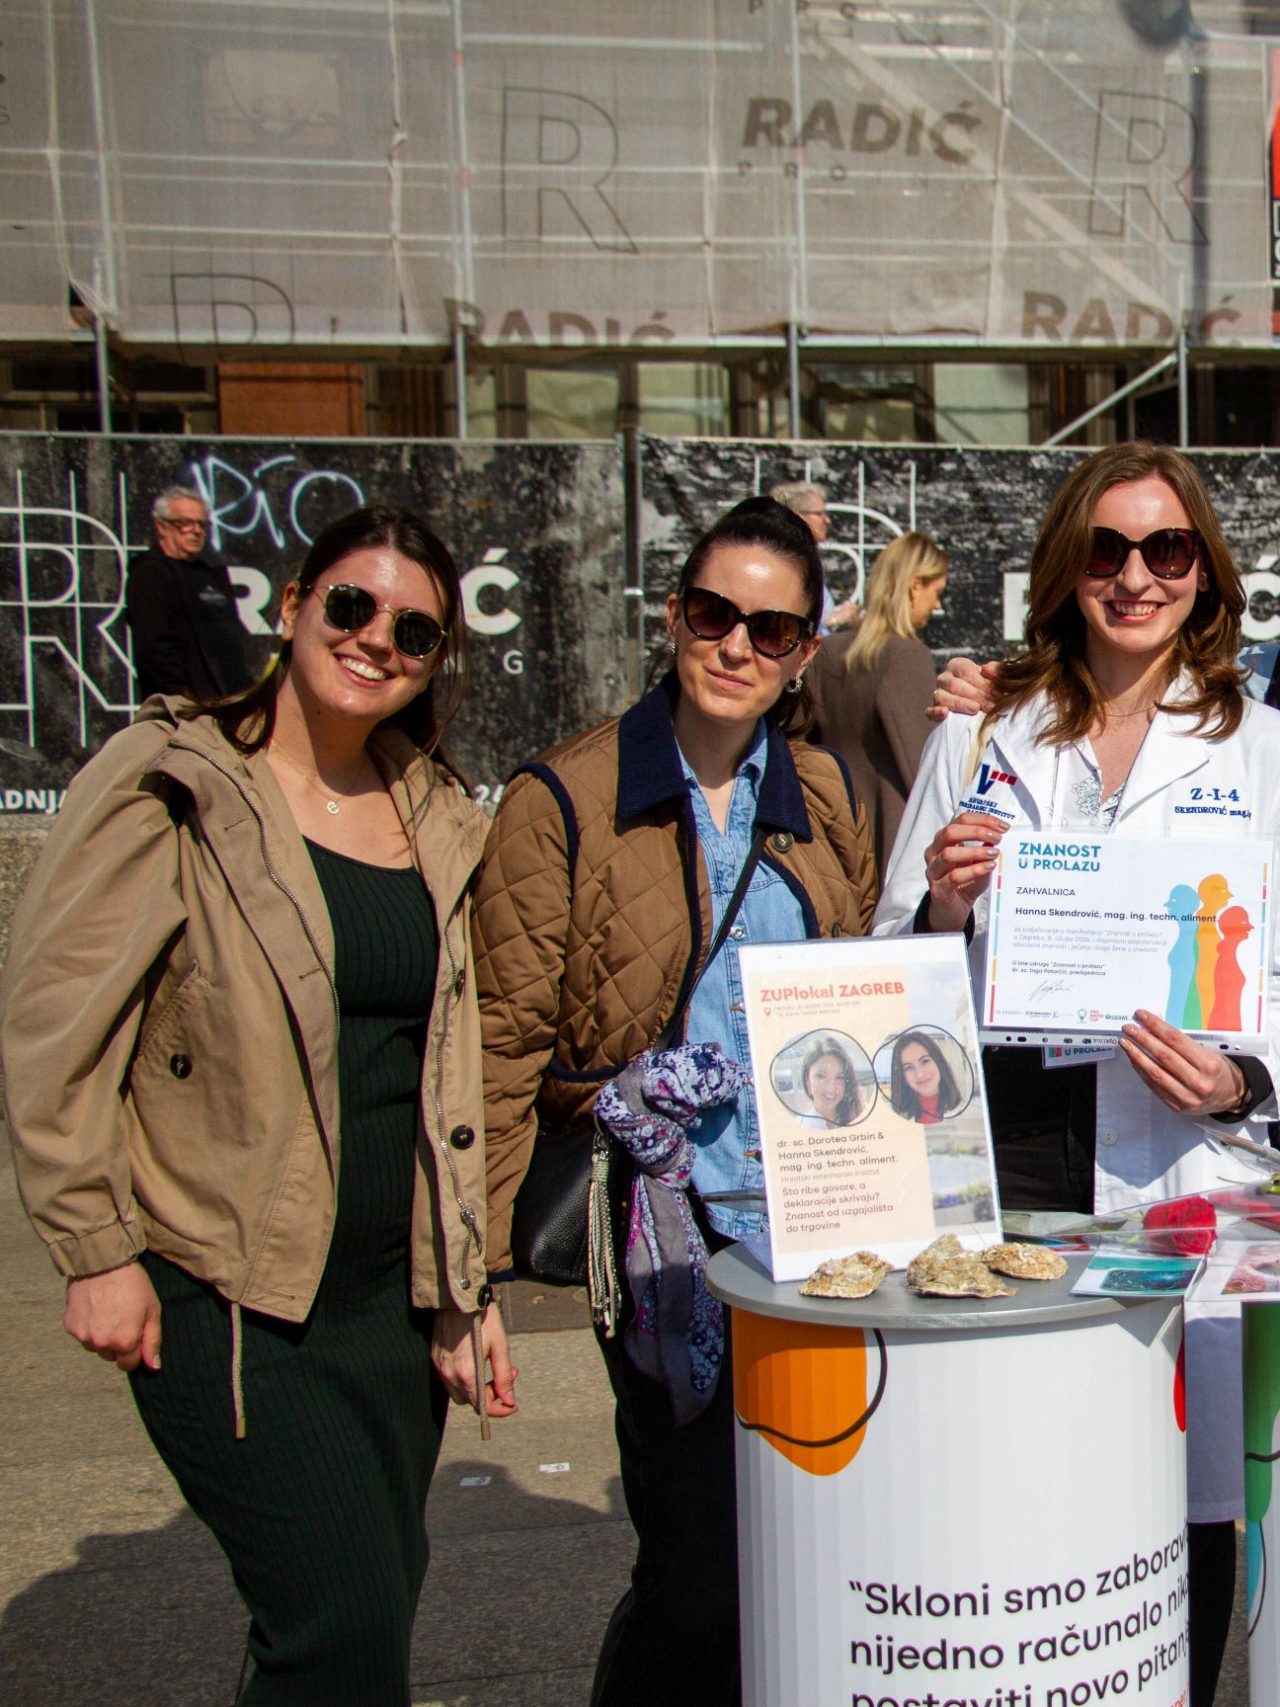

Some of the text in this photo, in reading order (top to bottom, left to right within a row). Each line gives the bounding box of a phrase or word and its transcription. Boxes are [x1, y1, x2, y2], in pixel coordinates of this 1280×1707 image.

[743, 97, 982, 166] RADIĆ
[1174, 805, 1228, 816] SKENDROVIĆ
[1018, 842, 1102, 858] ZNANOST
[1018, 858, 1101, 873] U PROLAZU
[1016, 886, 1076, 897] ZAHVALNICA
[1015, 907, 1220, 923] Hanna Skendrović, mag. ing. techn. aliment.
[760, 981, 906, 1003] ZUPlokal ZAGREB
[777, 1131, 885, 1148] dr. sc. Dorotea Grbin &
[778, 1150, 812, 1161] Hanna
[801, 1185, 820, 1195] ribe
[859, 1182, 866, 1190] a
[783, 1192, 880, 1209] deklaracije skrivaju?
[785, 1210, 825, 1221] Znanost
[827, 1207, 840, 1217] od
[786, 1220, 841, 1233] do trgovine
[1004, 1578, 1086, 1614] smo
[850, 1633, 1005, 1676] nijedno
[1018, 1600, 1162, 1665] računalo
[1047, 1668, 1129, 1707] novo
